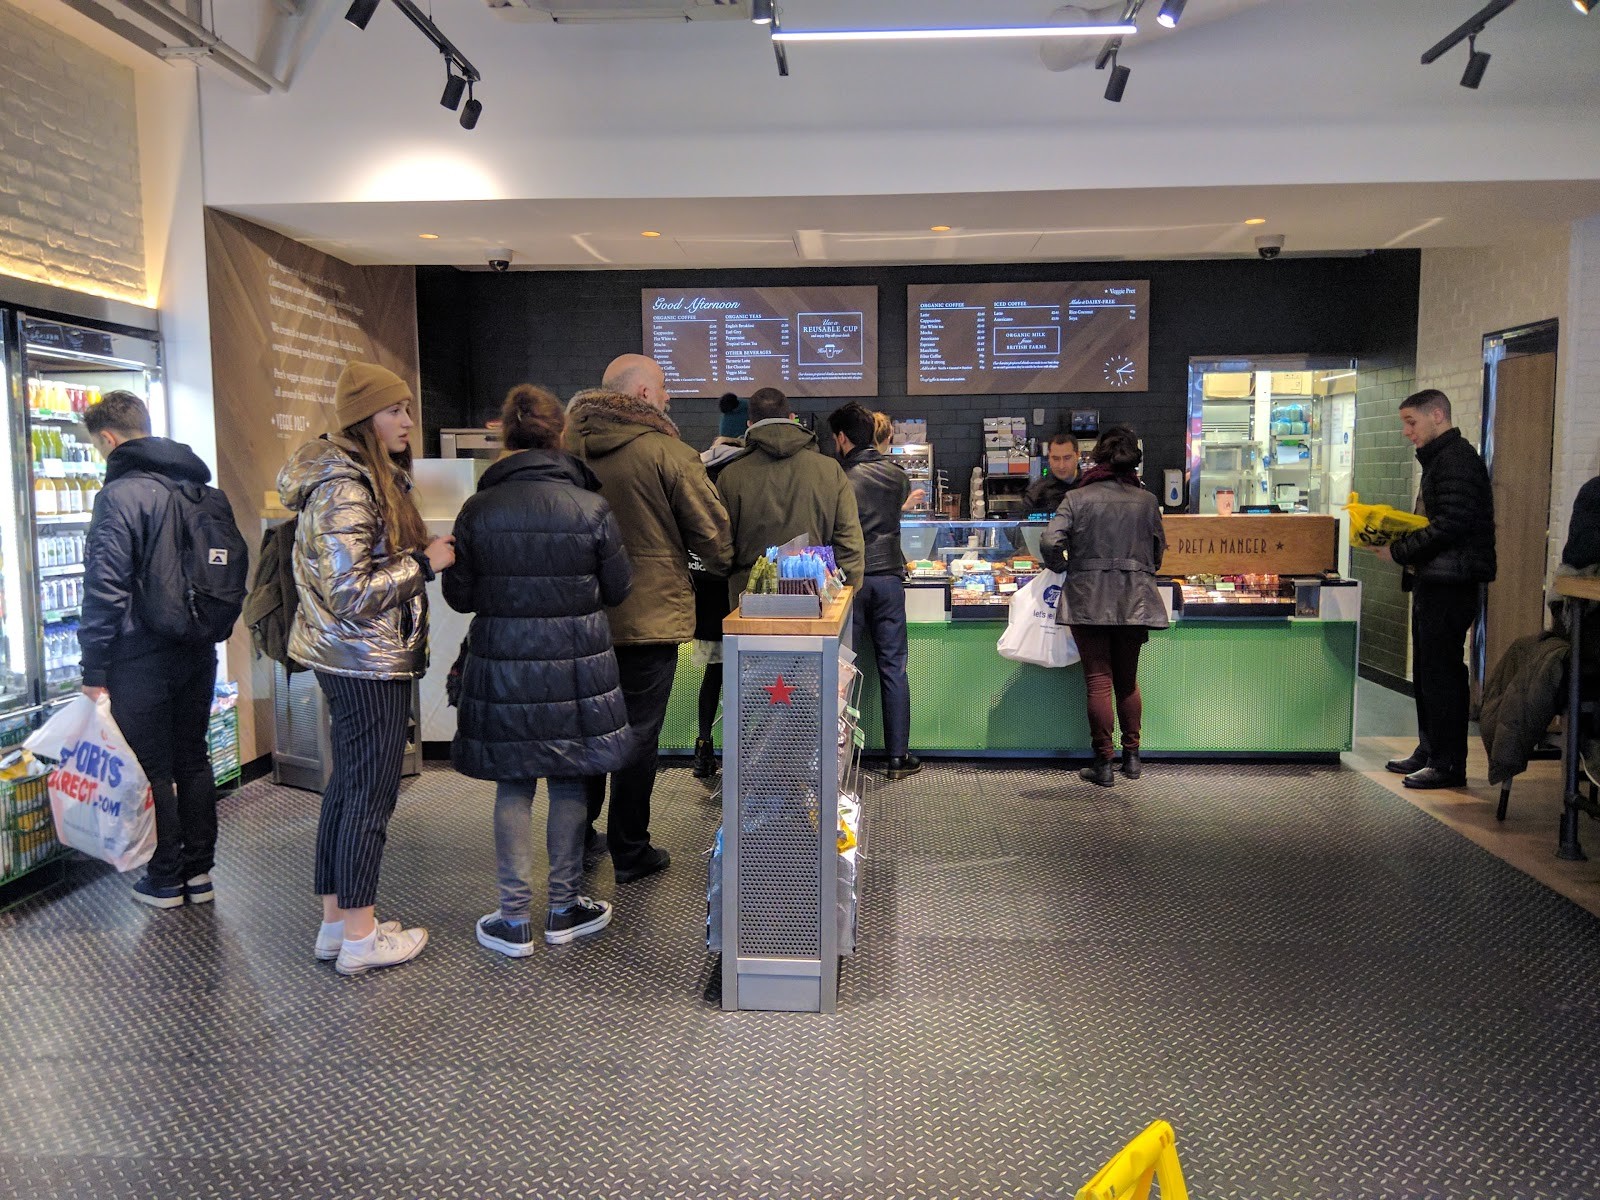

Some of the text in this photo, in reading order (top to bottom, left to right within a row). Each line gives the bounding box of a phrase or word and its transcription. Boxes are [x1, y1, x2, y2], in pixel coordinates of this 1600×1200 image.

[652, 297, 740, 313] Good Afternoon
[1179, 538, 1267, 553] PRET A MANGER
